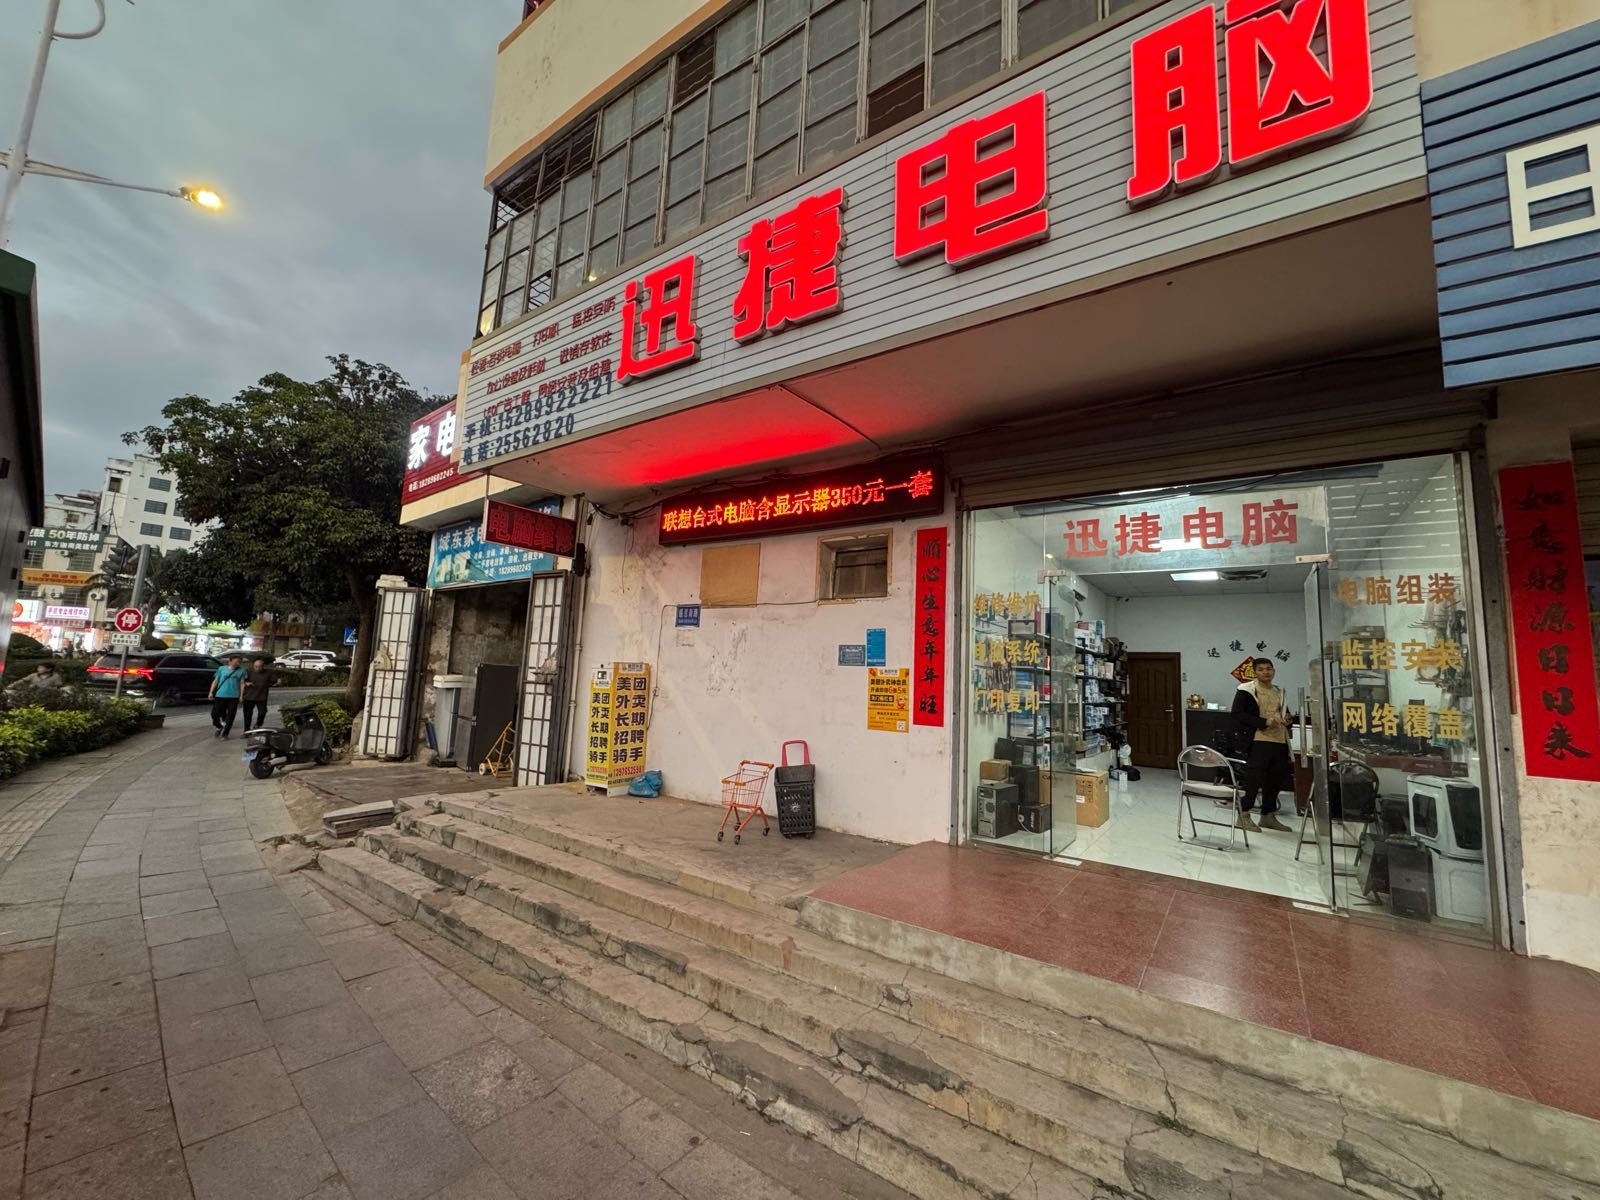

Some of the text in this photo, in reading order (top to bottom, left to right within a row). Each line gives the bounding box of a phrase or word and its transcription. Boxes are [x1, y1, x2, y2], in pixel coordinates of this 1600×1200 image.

[616, 0, 1374, 386] 迅捷电脑
[663, 470, 933, 532] 联想台式电脑含显示器350元一套
[1063, 499, 1298, 558] 迅捷电脑
[1337, 573, 1457, 608] 电脑组装
[120, 612, 138, 628] 停
[919, 538, 941, 715] 顺心生意年年旺
[975, 640, 1040, 664] 电脑系统
[1341, 639, 1464, 672] 监控安装
[617, 677, 646, 691] 美团
[592, 693, 610, 704] 美团
[615, 694, 646, 709] 外卖
[974, 687, 1040, 714] 打印复印
[592, 707, 610, 719] 外卖
[615, 712, 645, 727] 长期
[591, 722, 608, 733] 长期
[1343, 702, 1467, 741] 网络覆盖
[590, 736, 608, 749] 招聘
[614, 730, 644, 745] 招聘
[589, 752, 607, 763] 骑手
[613, 747, 643, 763] 骑手
